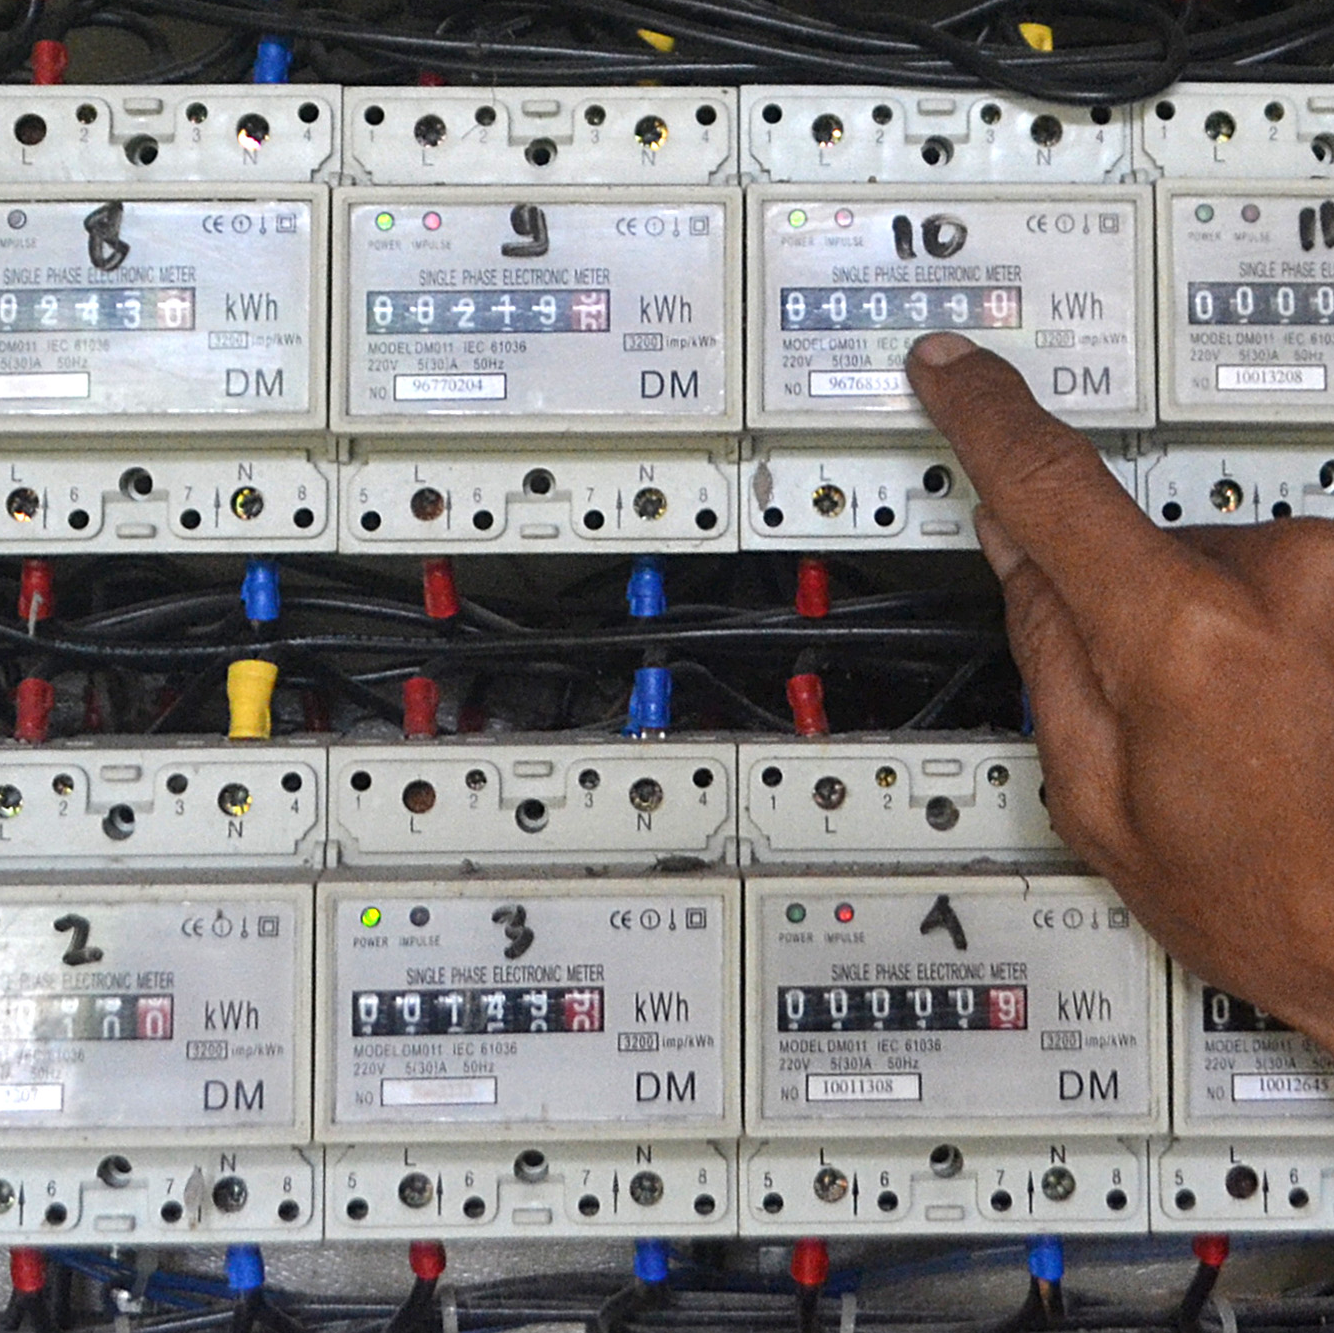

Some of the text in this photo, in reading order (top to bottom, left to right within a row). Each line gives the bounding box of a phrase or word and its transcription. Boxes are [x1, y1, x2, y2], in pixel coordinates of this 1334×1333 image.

[892, 213, 968, 259] 10
[418, 267, 610, 286] SINGLE PHASE ELECTRONIC METER
[831, 264, 1022, 282] SINGLE PHASE ELECTRONIC METER
[1238, 261, 1275, 278] SINGLE
[1280, 261, 1315, 278] PHASE
[225, 291, 279, 321] kWh
[640, 294, 693, 323] kWh
[1051, 291, 1103, 320] kWh
[367, 340, 526, 354] MODEL DM011 IEC 61036
[629, 334, 717, 349] 3200 imp/kWh
[224, 367, 284, 397] DM
[412, 378, 482, 392] 96770204
[640, 369, 698, 399] DM
[1052, 365, 1110, 395] DM
[1235, 369, 1302, 384] 10013208
[52, 913, 104, 965] 2
[491, 904, 533, 959] 3
[778, 931, 865, 943] POWER IMPULSE
[405, 963, 604, 985] SINGLE PHASE ELECTRONIC METER
[831, 962, 1027, 981] SINGLE PHASE ELECTRONIC METER
[202, 998, 258, 1029] kWh
[635, 990, 689, 1022] kWh
[784, 989, 1112, 1027] 000009 kWh
[779, 1038, 941, 1053] MODEL DM011 IEC 61036
[1047, 1033, 1137, 1048] 3200 imp/kWh
[200, 1077, 262, 1108] DM
[635, 1070, 696, 1102] DM
[823, 1079, 893, 1094] 10011308
[1058, 1069, 1118, 1100] DM
[1259, 1077, 1329, 1092] 10012645
